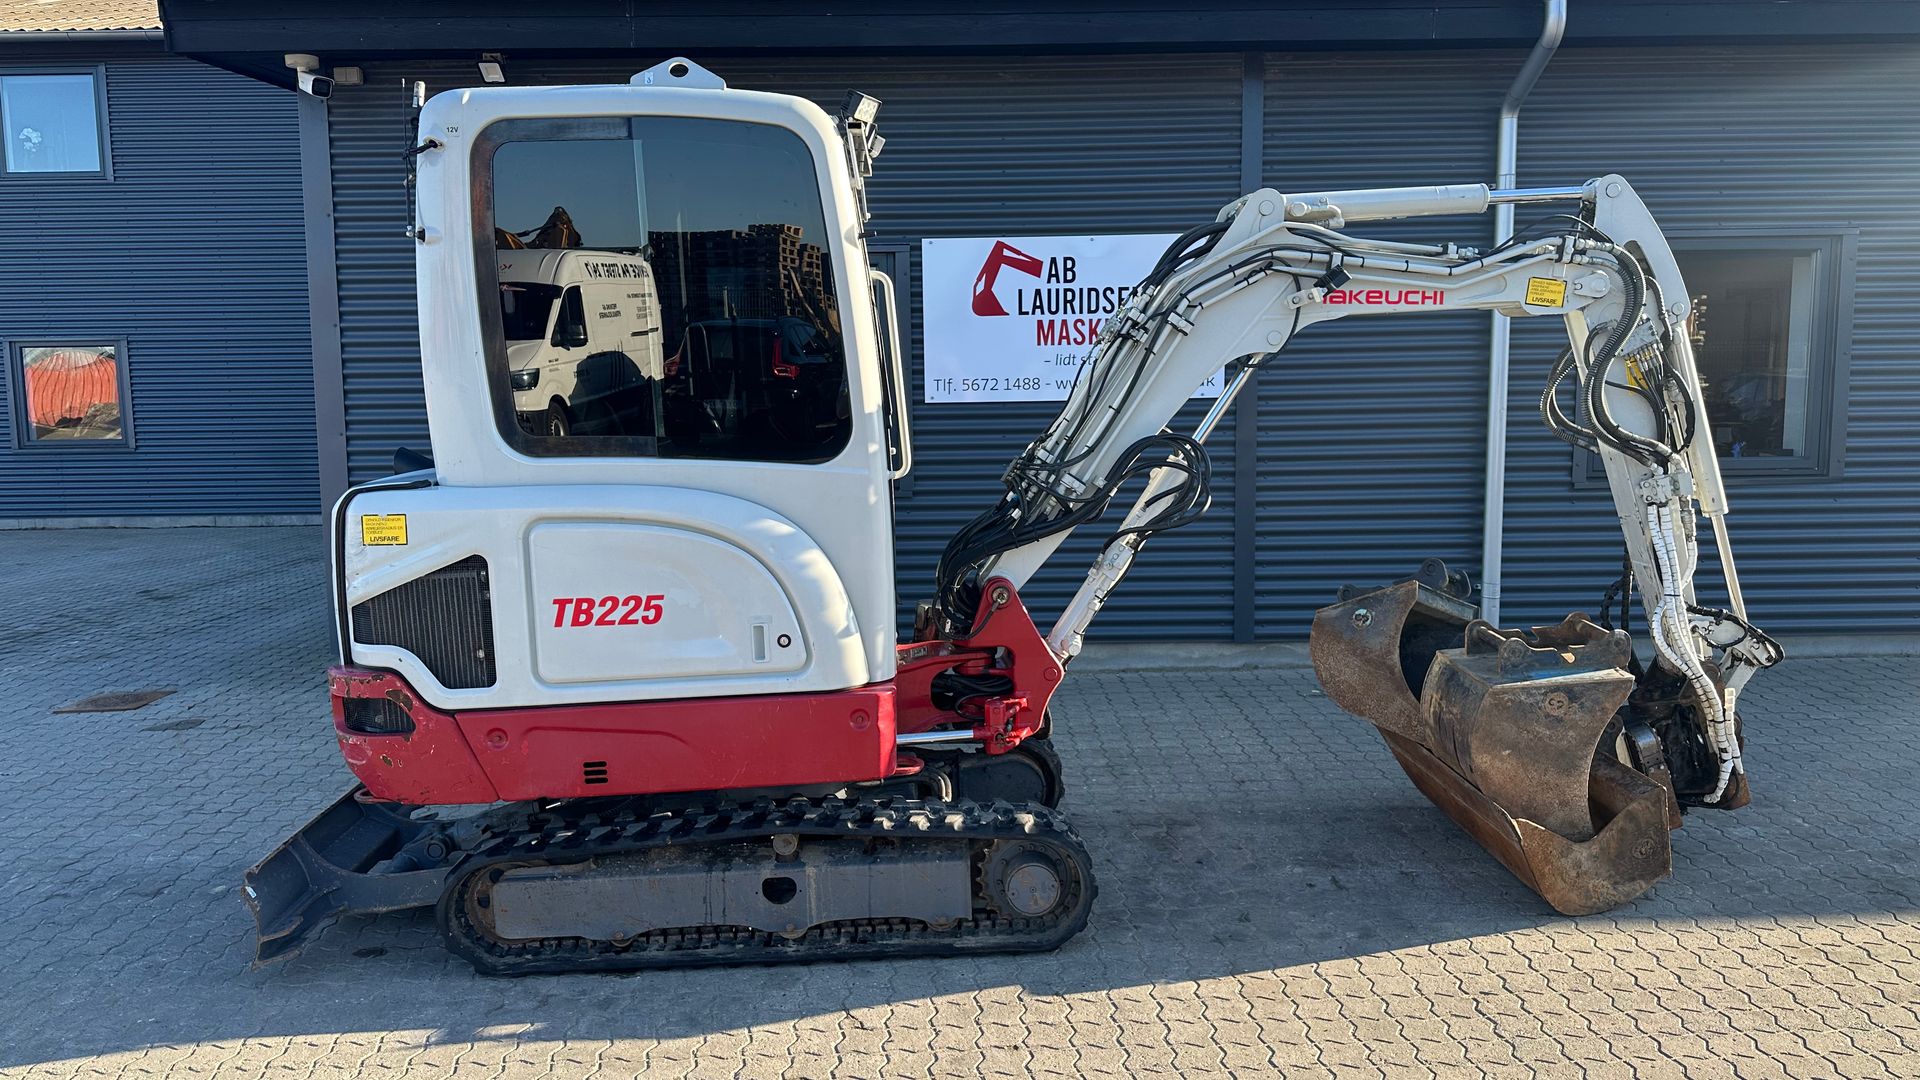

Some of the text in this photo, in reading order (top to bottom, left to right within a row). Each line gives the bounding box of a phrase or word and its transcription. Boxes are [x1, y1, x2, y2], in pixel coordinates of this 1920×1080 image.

[1046, 256, 1076, 284] AB
[1018, 286, 1136, 316] LAURIDSE
[1531, 296, 1558, 305] LIVSFARE
[1037, 318, 1105, 347] MASK
[1055, 353, 1077, 366] lidt
[933, 378, 957, 395] Tlf.
[962, 378, 999, 391] 5672
[1003, 377, 1041, 391] 1488
[369, 535, 400, 543] LIVSFARE
[552, 594, 665, 628] TB225
